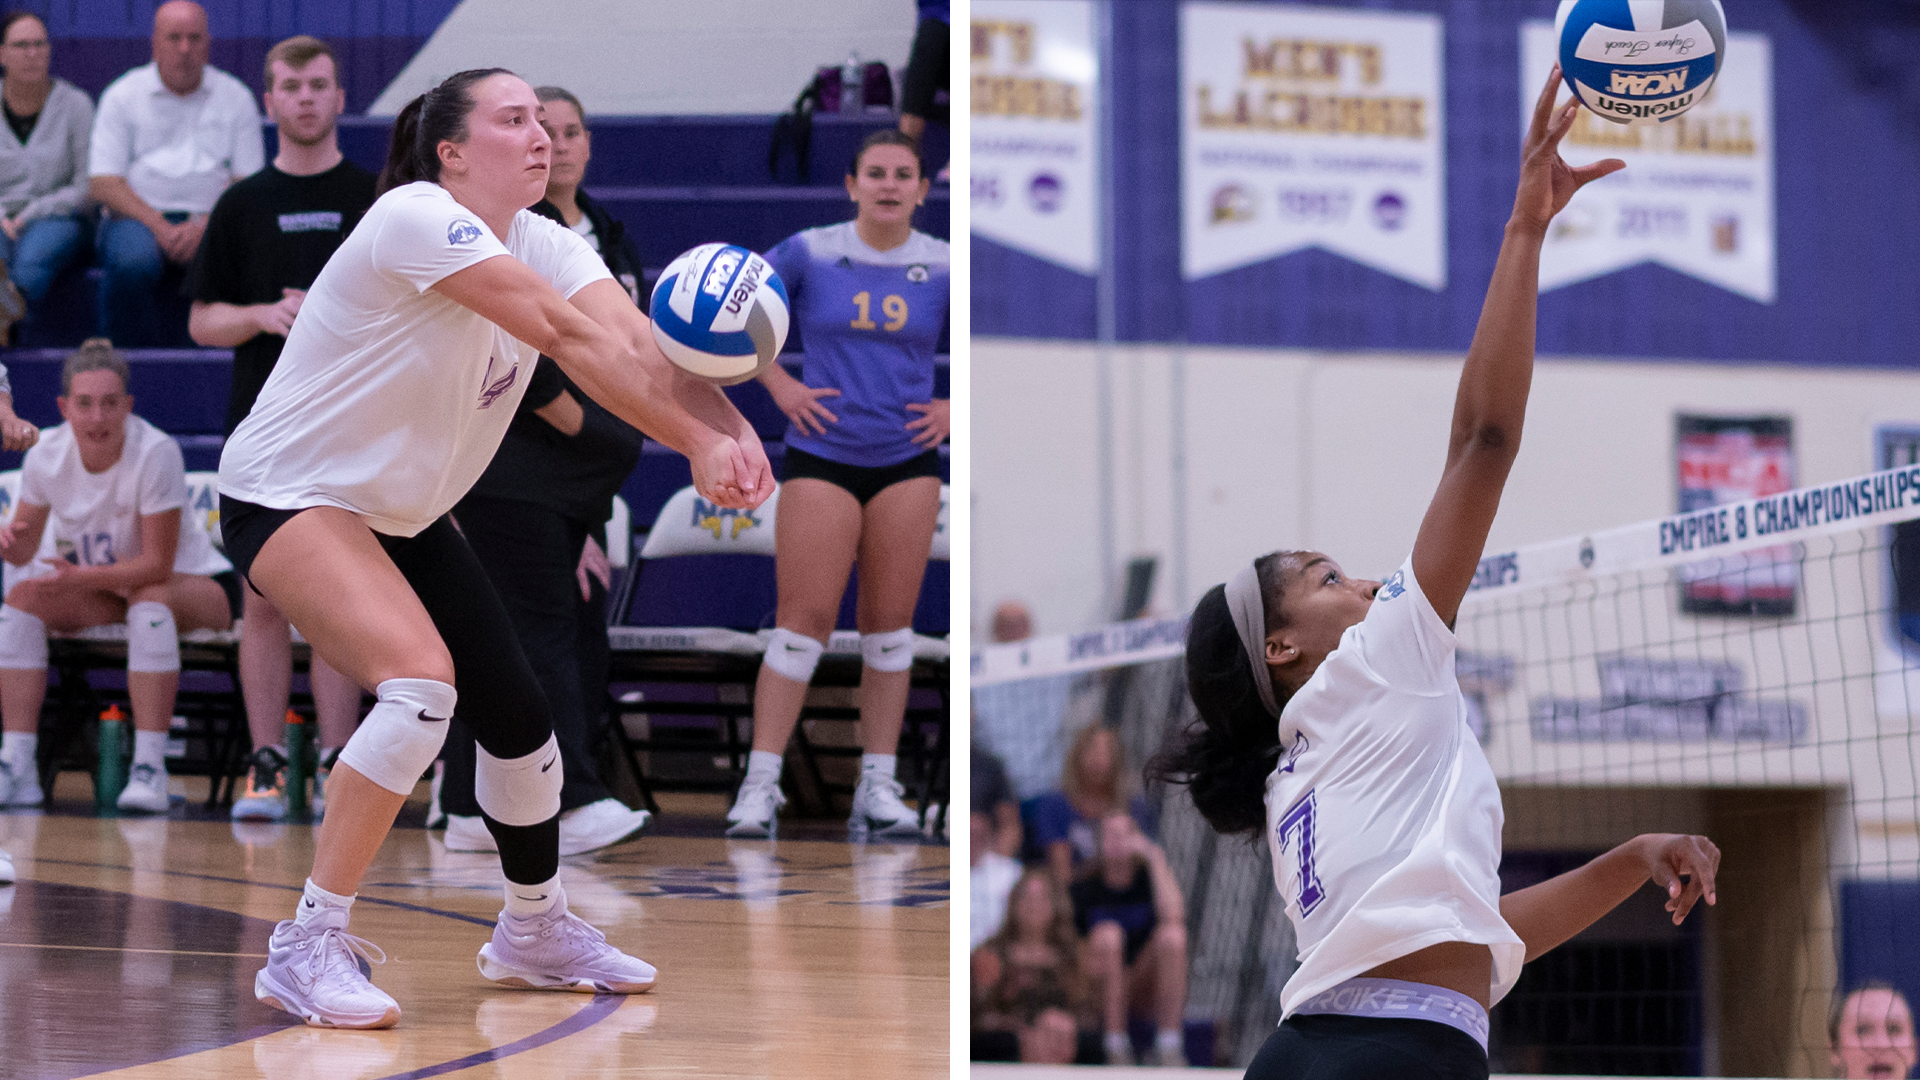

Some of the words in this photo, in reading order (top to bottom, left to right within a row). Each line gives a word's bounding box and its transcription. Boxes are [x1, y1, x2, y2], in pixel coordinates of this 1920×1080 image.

[1605, 40, 1649, 57] Touch
[1655, 34, 1696, 55] Super
[1610, 69, 1687, 96] NCAA
[1598, 93, 1693, 118] molten
[725, 257, 765, 316] molten
[850, 291, 908, 332] 19
[1659, 510, 1731, 556] EMPIRE
[1735, 505, 1749, 541] 8
[1754, 467, 1920, 537] CHAMPIONSHIPS
[1276, 787, 1327, 919] 7
